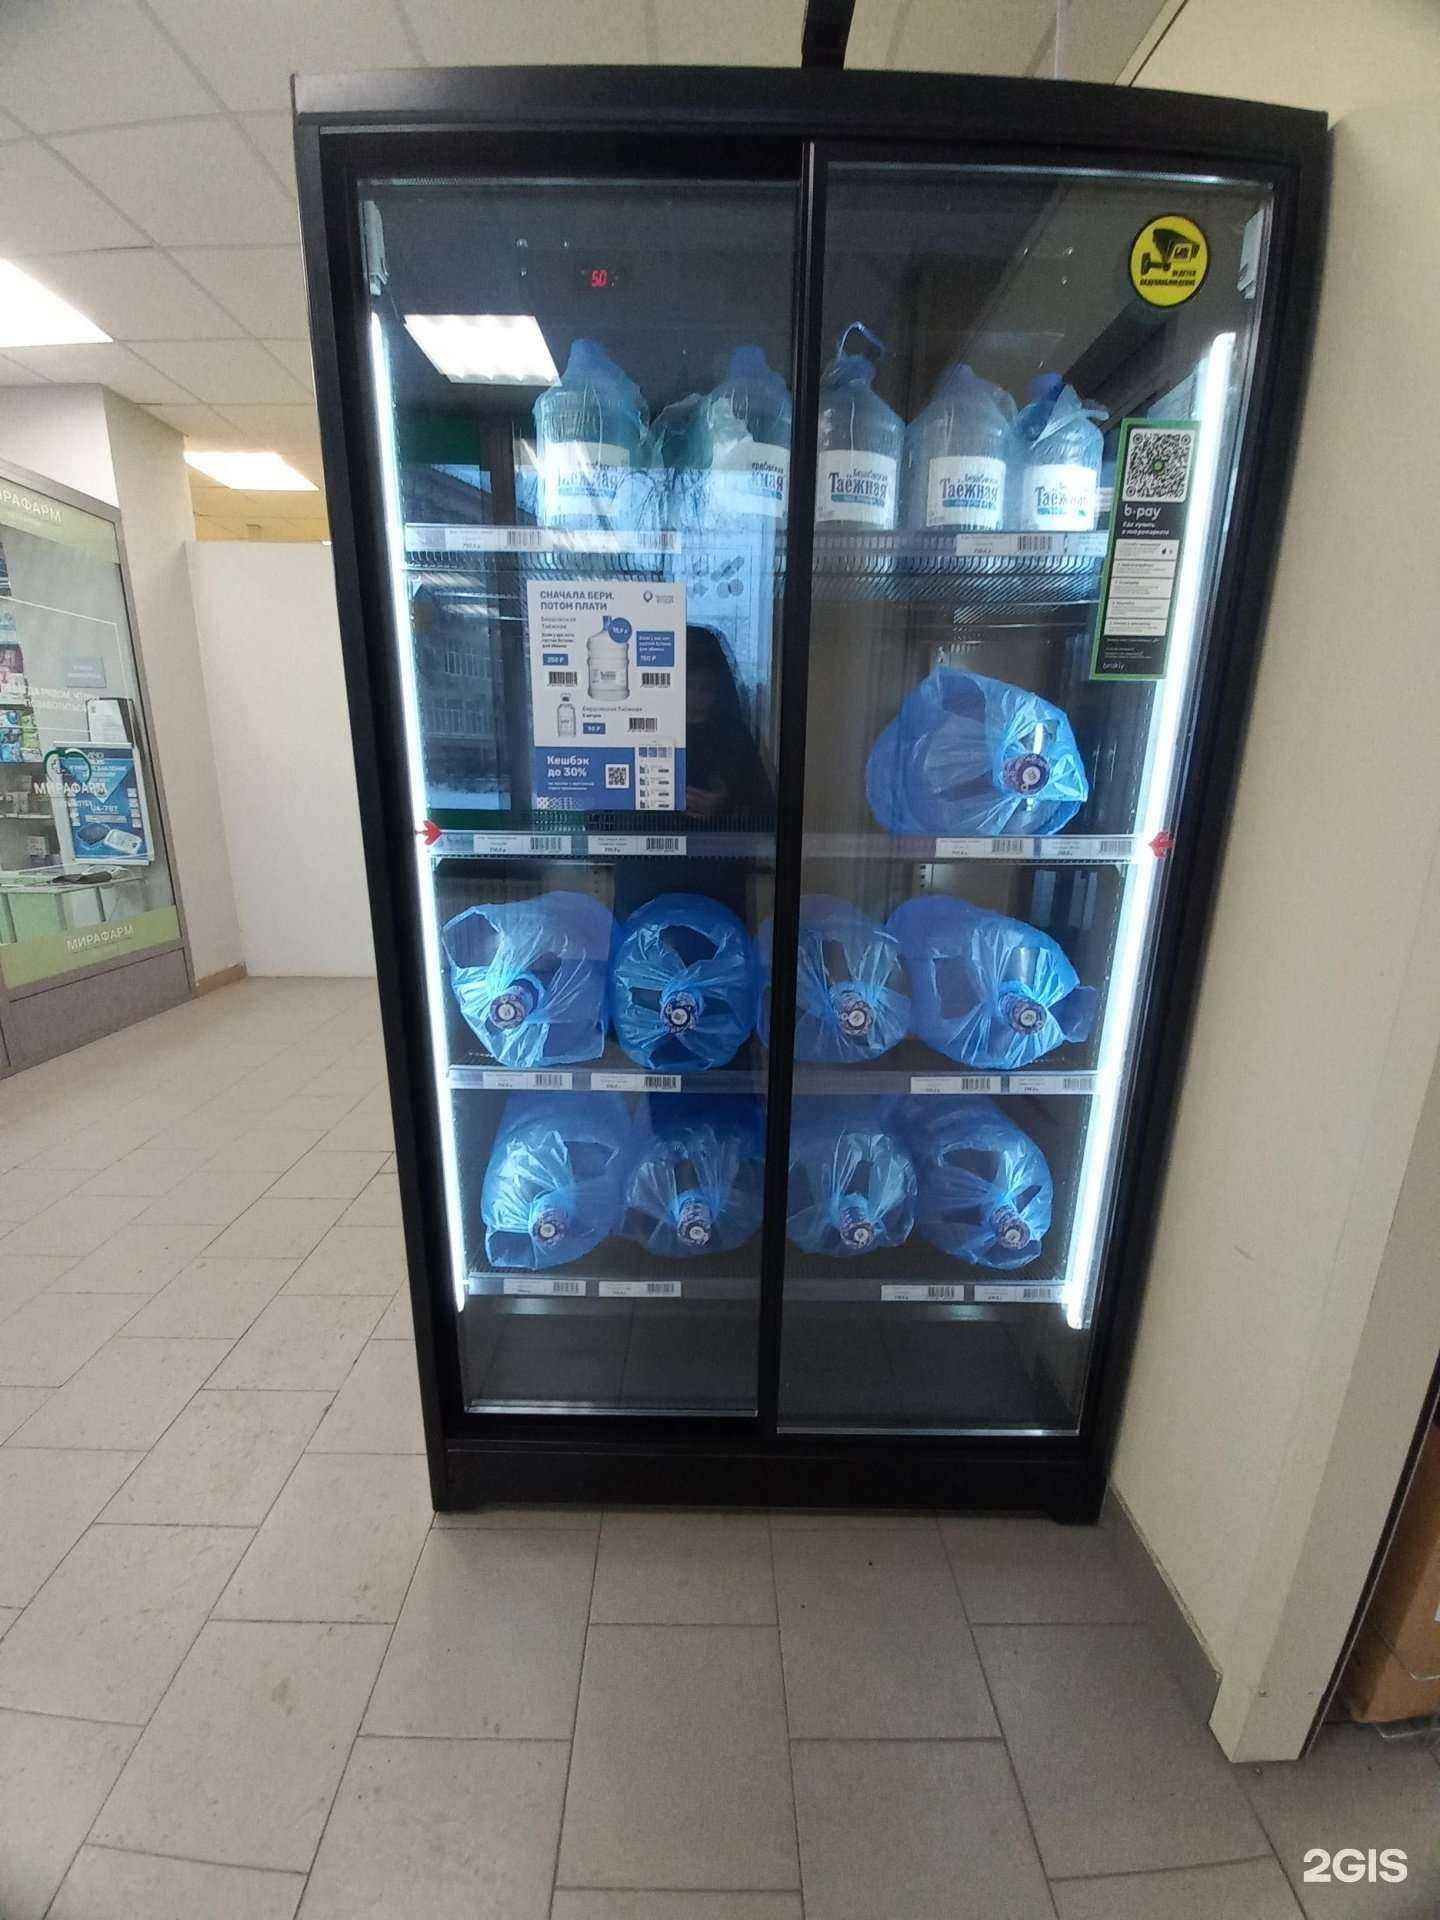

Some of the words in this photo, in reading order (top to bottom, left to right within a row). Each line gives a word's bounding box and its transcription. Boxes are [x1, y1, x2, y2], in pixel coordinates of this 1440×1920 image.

[540, 590, 586, 600] СНАЧАЛА
[541, 602, 573, 610] ПОТОМ
[575, 602, 608, 611] ПЛАТИ
[547, 755, 590, 766] Кешбэк
[548, 768, 561, 778] до
[563, 767, 587, 777] 30%
[66, 924, 135, 952] МИРАФАРМ
